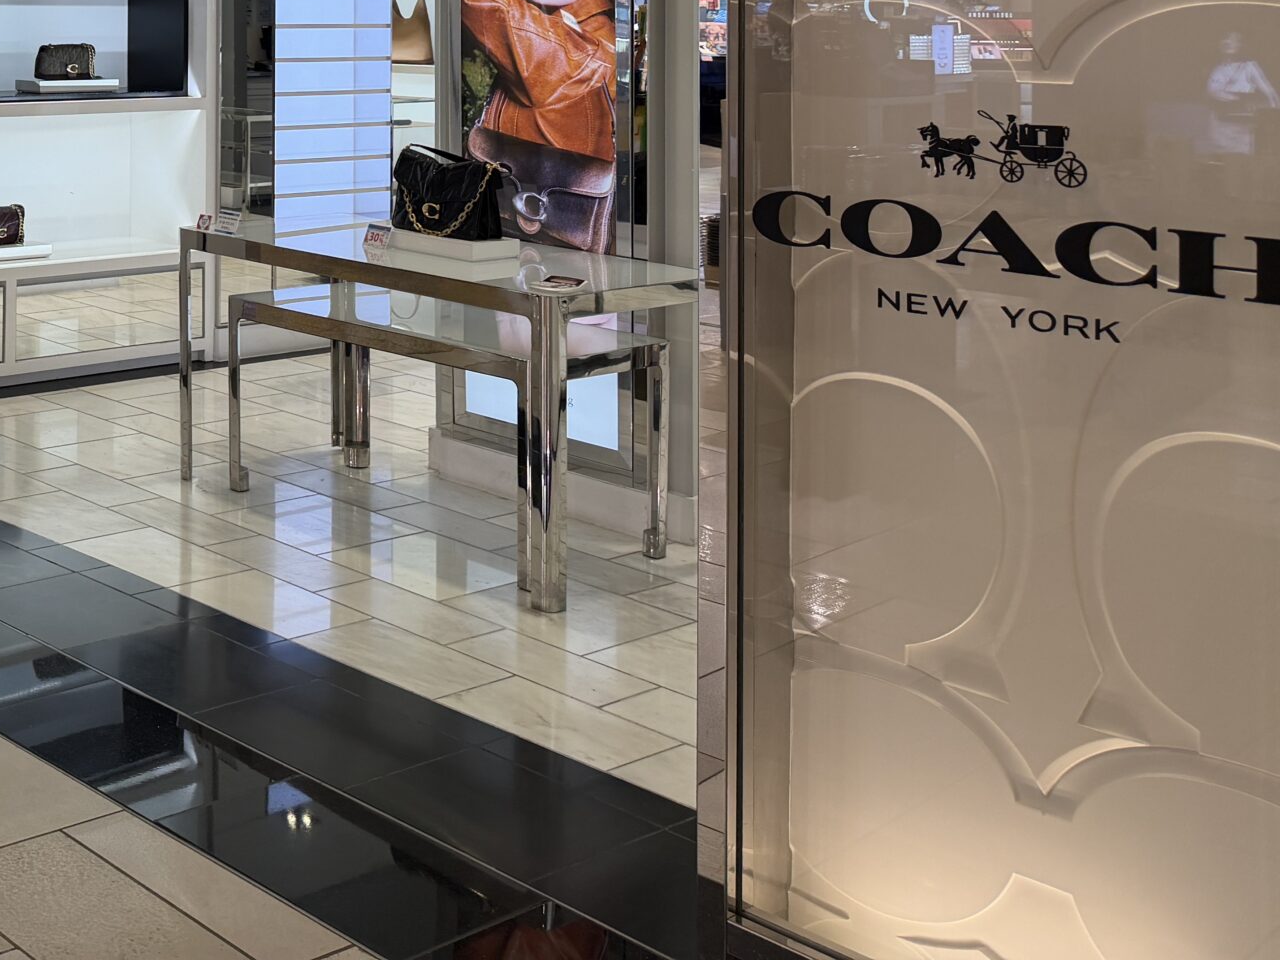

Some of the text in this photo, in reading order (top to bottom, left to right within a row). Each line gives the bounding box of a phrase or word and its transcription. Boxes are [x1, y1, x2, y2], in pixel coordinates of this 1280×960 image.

[751, 190, 1280, 306] COACH
[877, 287, 1121, 344] NEW YORK
